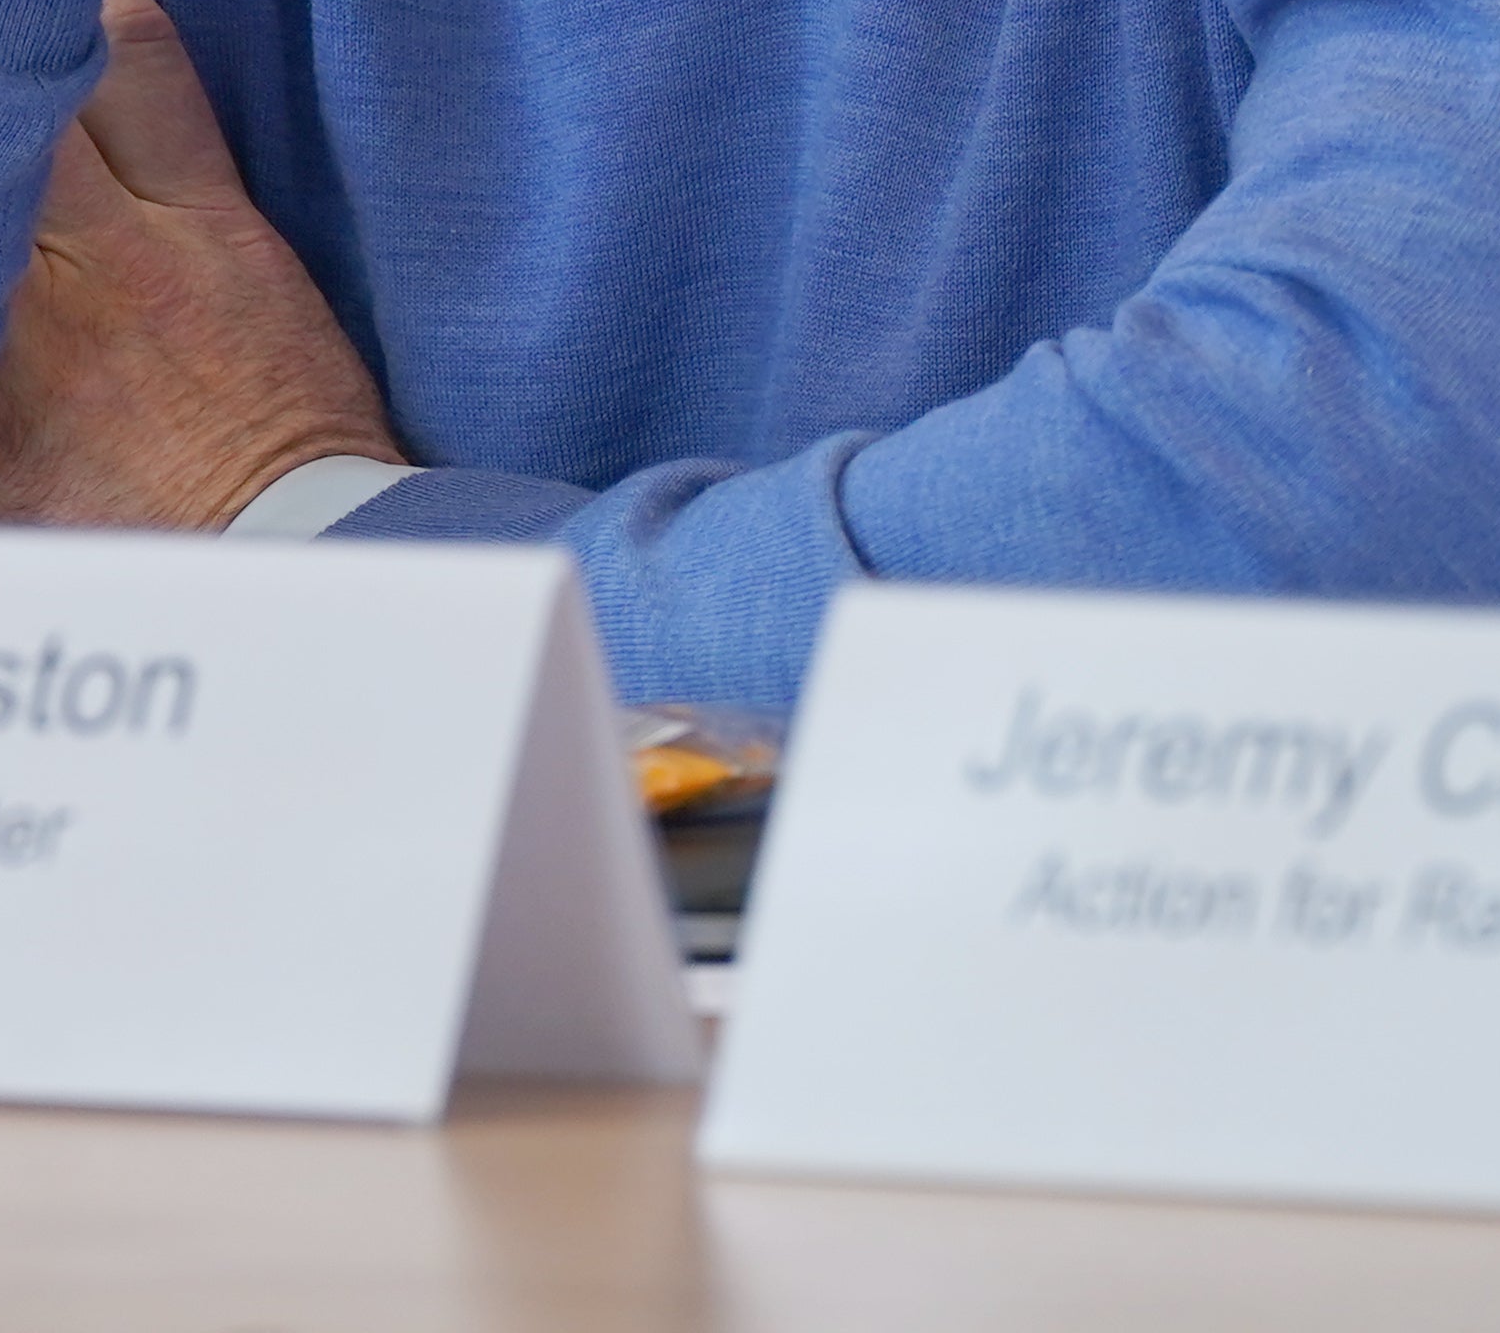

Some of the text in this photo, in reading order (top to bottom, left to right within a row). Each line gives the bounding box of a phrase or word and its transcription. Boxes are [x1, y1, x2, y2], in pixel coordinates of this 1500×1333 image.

[960, 683, 1392, 841] Jeremy
[1008, 848, 1262, 941] Action
[1270, 858, 1383, 948] for
